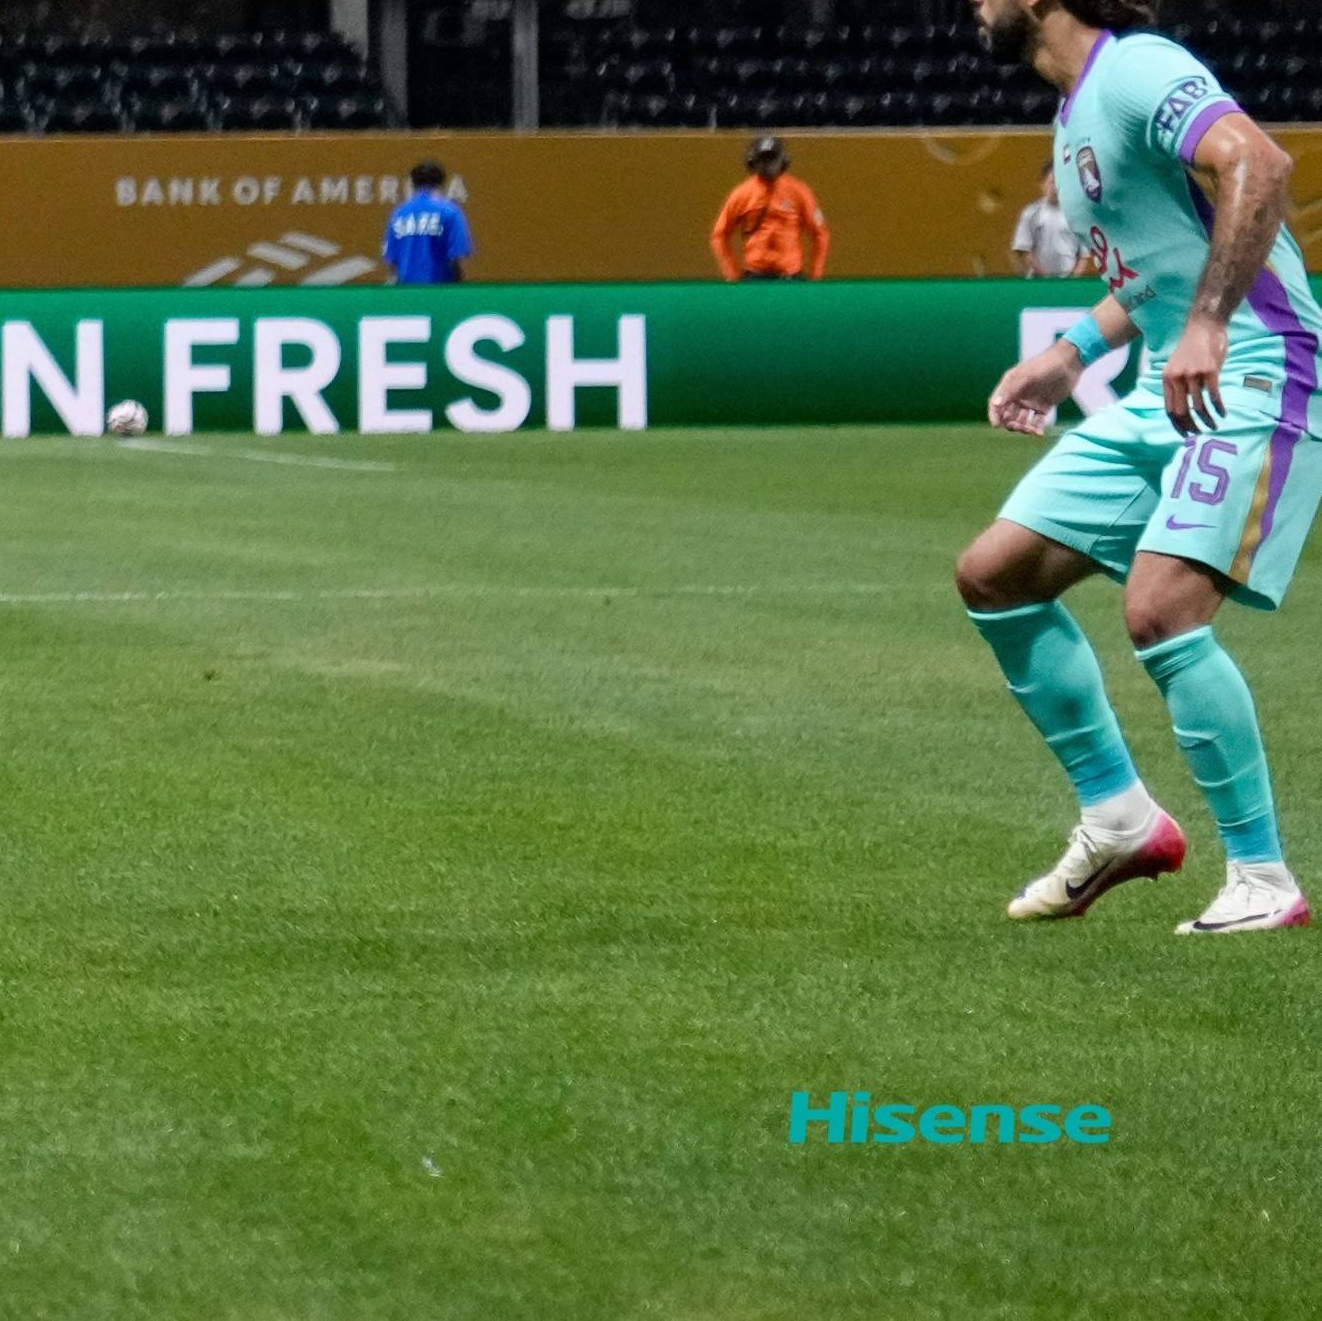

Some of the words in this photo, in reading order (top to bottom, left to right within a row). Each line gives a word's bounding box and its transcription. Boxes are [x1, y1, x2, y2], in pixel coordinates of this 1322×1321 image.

[114, 176, 221, 206] BANK
[231, 175, 282, 205] OF
[291, 174, 469, 204] AMERIA
[164, 315, 647, 436] FRESH
[1170, 434, 1238, 506] 15
